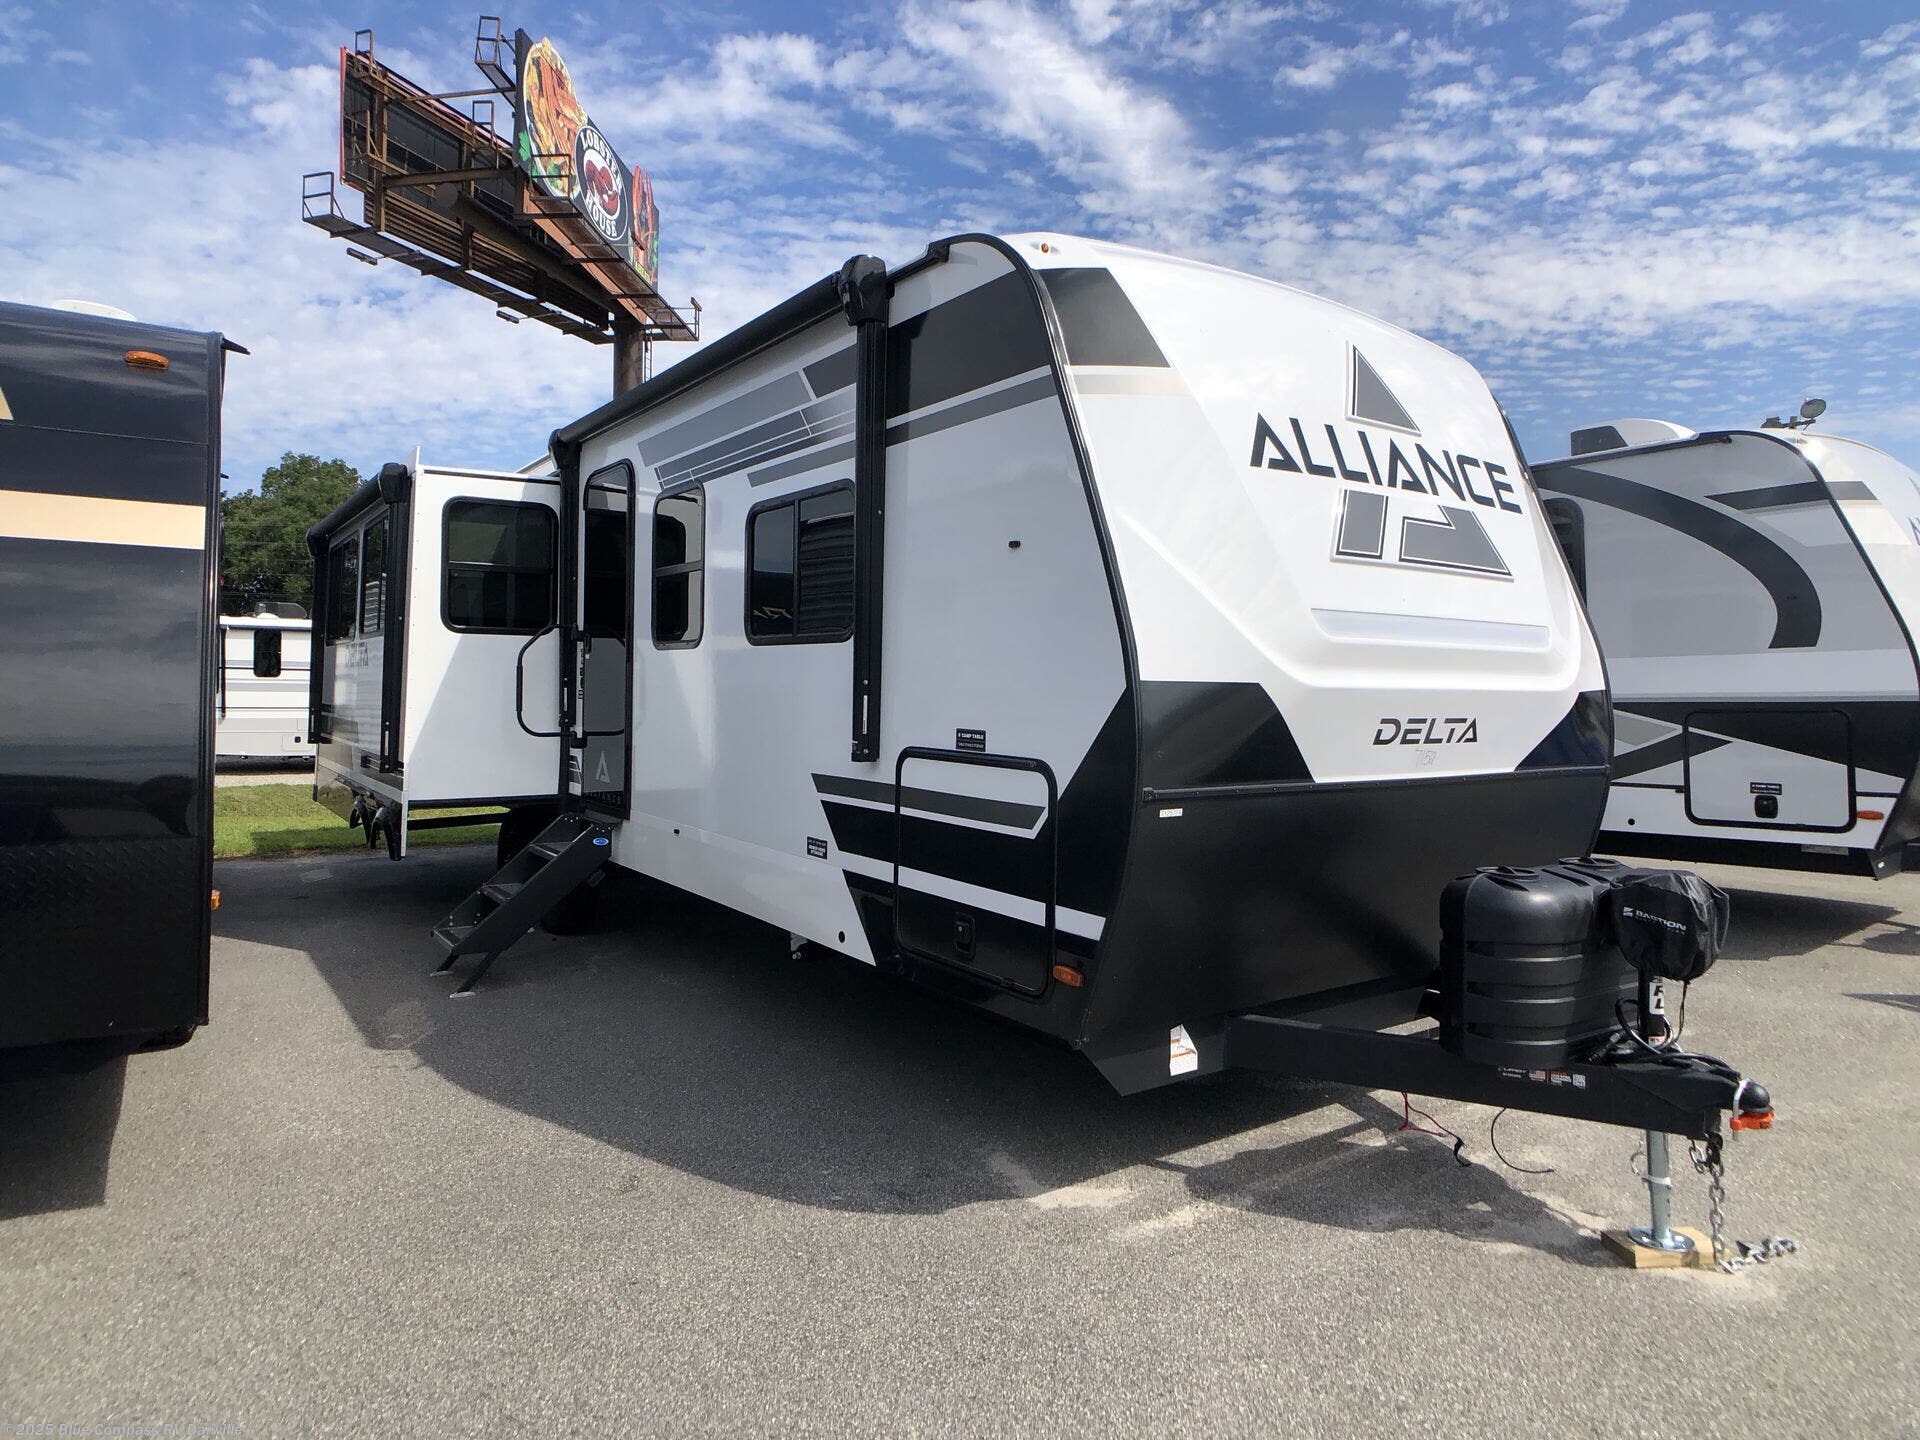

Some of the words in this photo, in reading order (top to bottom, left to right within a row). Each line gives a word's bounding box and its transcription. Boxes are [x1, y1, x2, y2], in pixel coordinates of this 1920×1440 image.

[585, 188, 617, 237] HOUSE
[1250, 412, 1522, 514] ALLIANCE
[1373, 718, 1478, 745] DELTA
